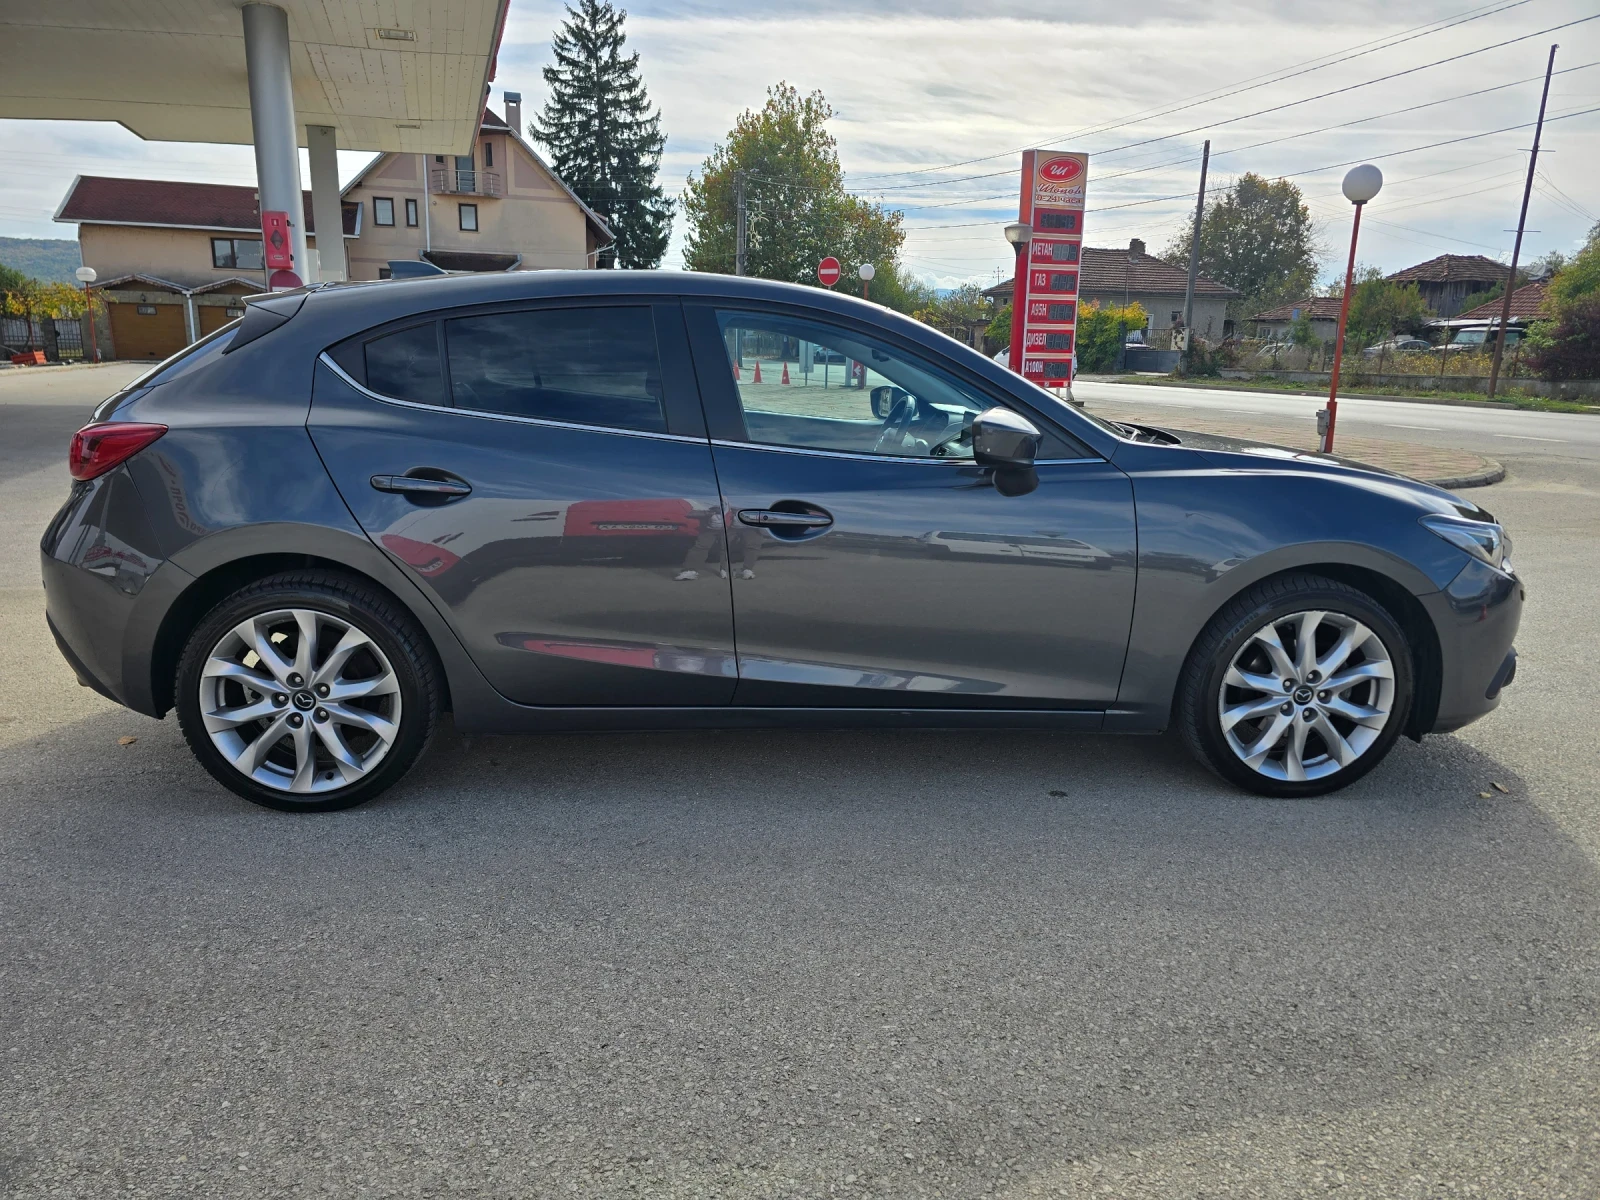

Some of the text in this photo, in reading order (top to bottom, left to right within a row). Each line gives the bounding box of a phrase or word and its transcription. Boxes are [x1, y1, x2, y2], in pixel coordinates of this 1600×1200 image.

[1032, 242, 1053, 256] МЕТАН
[1034, 273, 1046, 286] ГАЗ
[1026, 332, 1047, 347] ДИЗЕЛ
